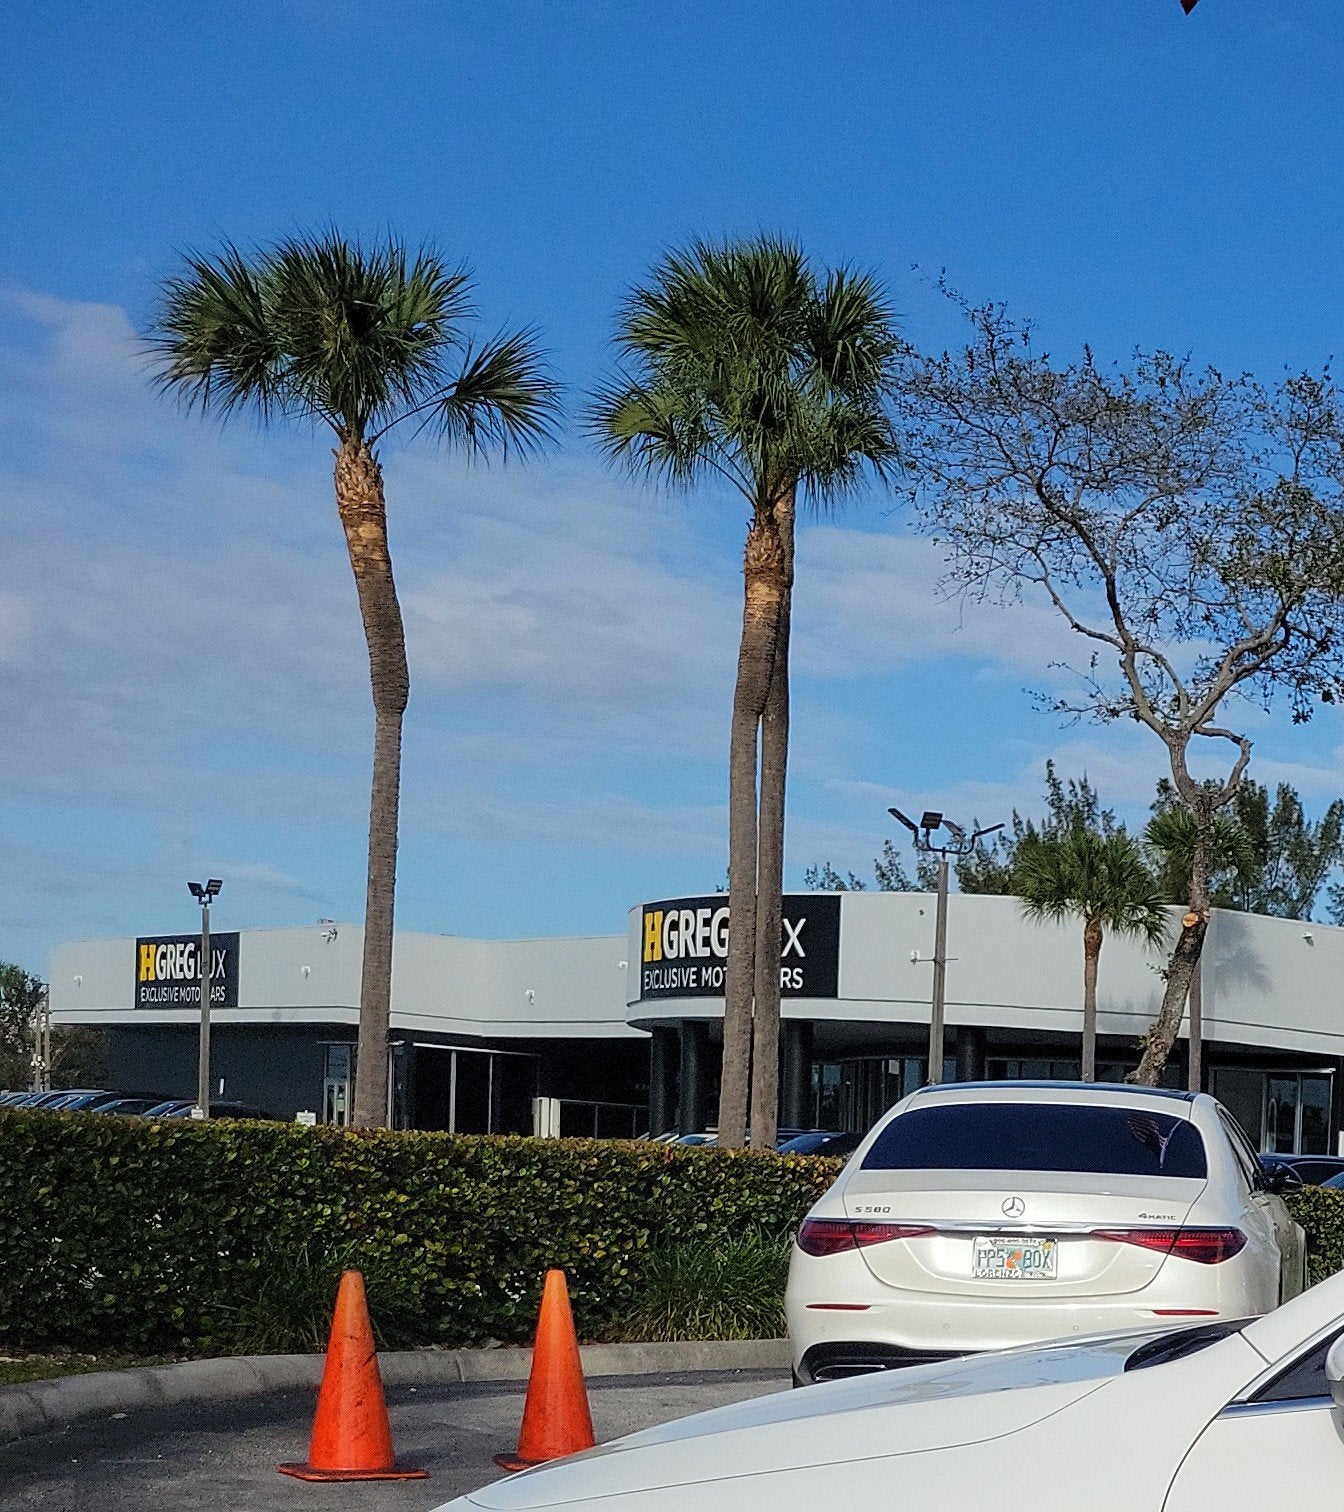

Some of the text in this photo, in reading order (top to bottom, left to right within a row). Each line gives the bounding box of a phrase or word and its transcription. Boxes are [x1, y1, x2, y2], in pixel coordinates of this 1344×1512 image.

[644, 967, 697, 990] EXCLUSIVE
[140, 985, 226, 1002] EXCLUSIVE MOTOARS
